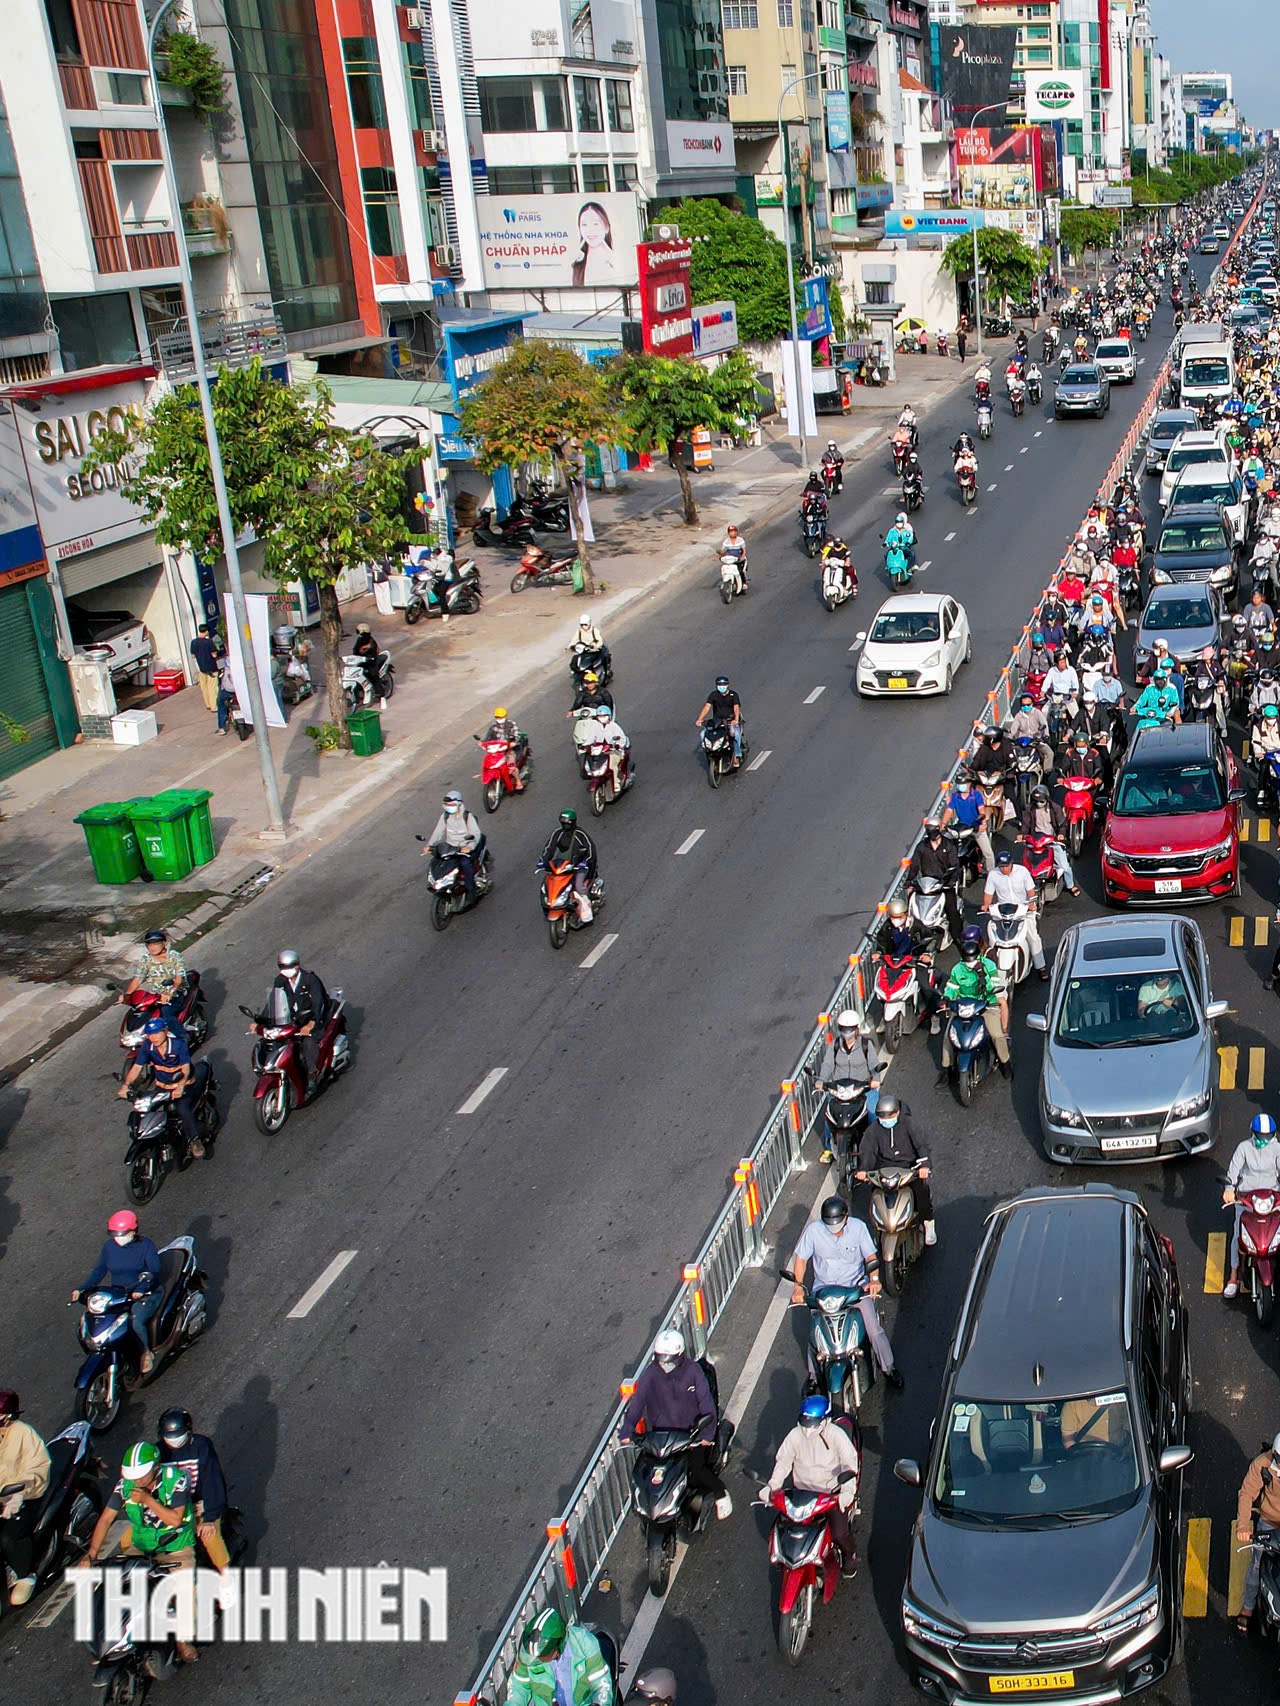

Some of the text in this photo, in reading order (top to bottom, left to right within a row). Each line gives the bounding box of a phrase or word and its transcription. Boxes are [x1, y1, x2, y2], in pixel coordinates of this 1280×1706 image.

[1035, 91, 1075, 99] TECAPRO
[683, 138, 714, 150] TECHCOMBANK
[917, 217, 968, 225] VIETBANK
[494, 229, 522, 240] THỐNG
[545, 231, 568, 239] KHOA
[486, 242, 567, 256] CHUẨN PHÁP
[34, 415, 84, 465] SAI
